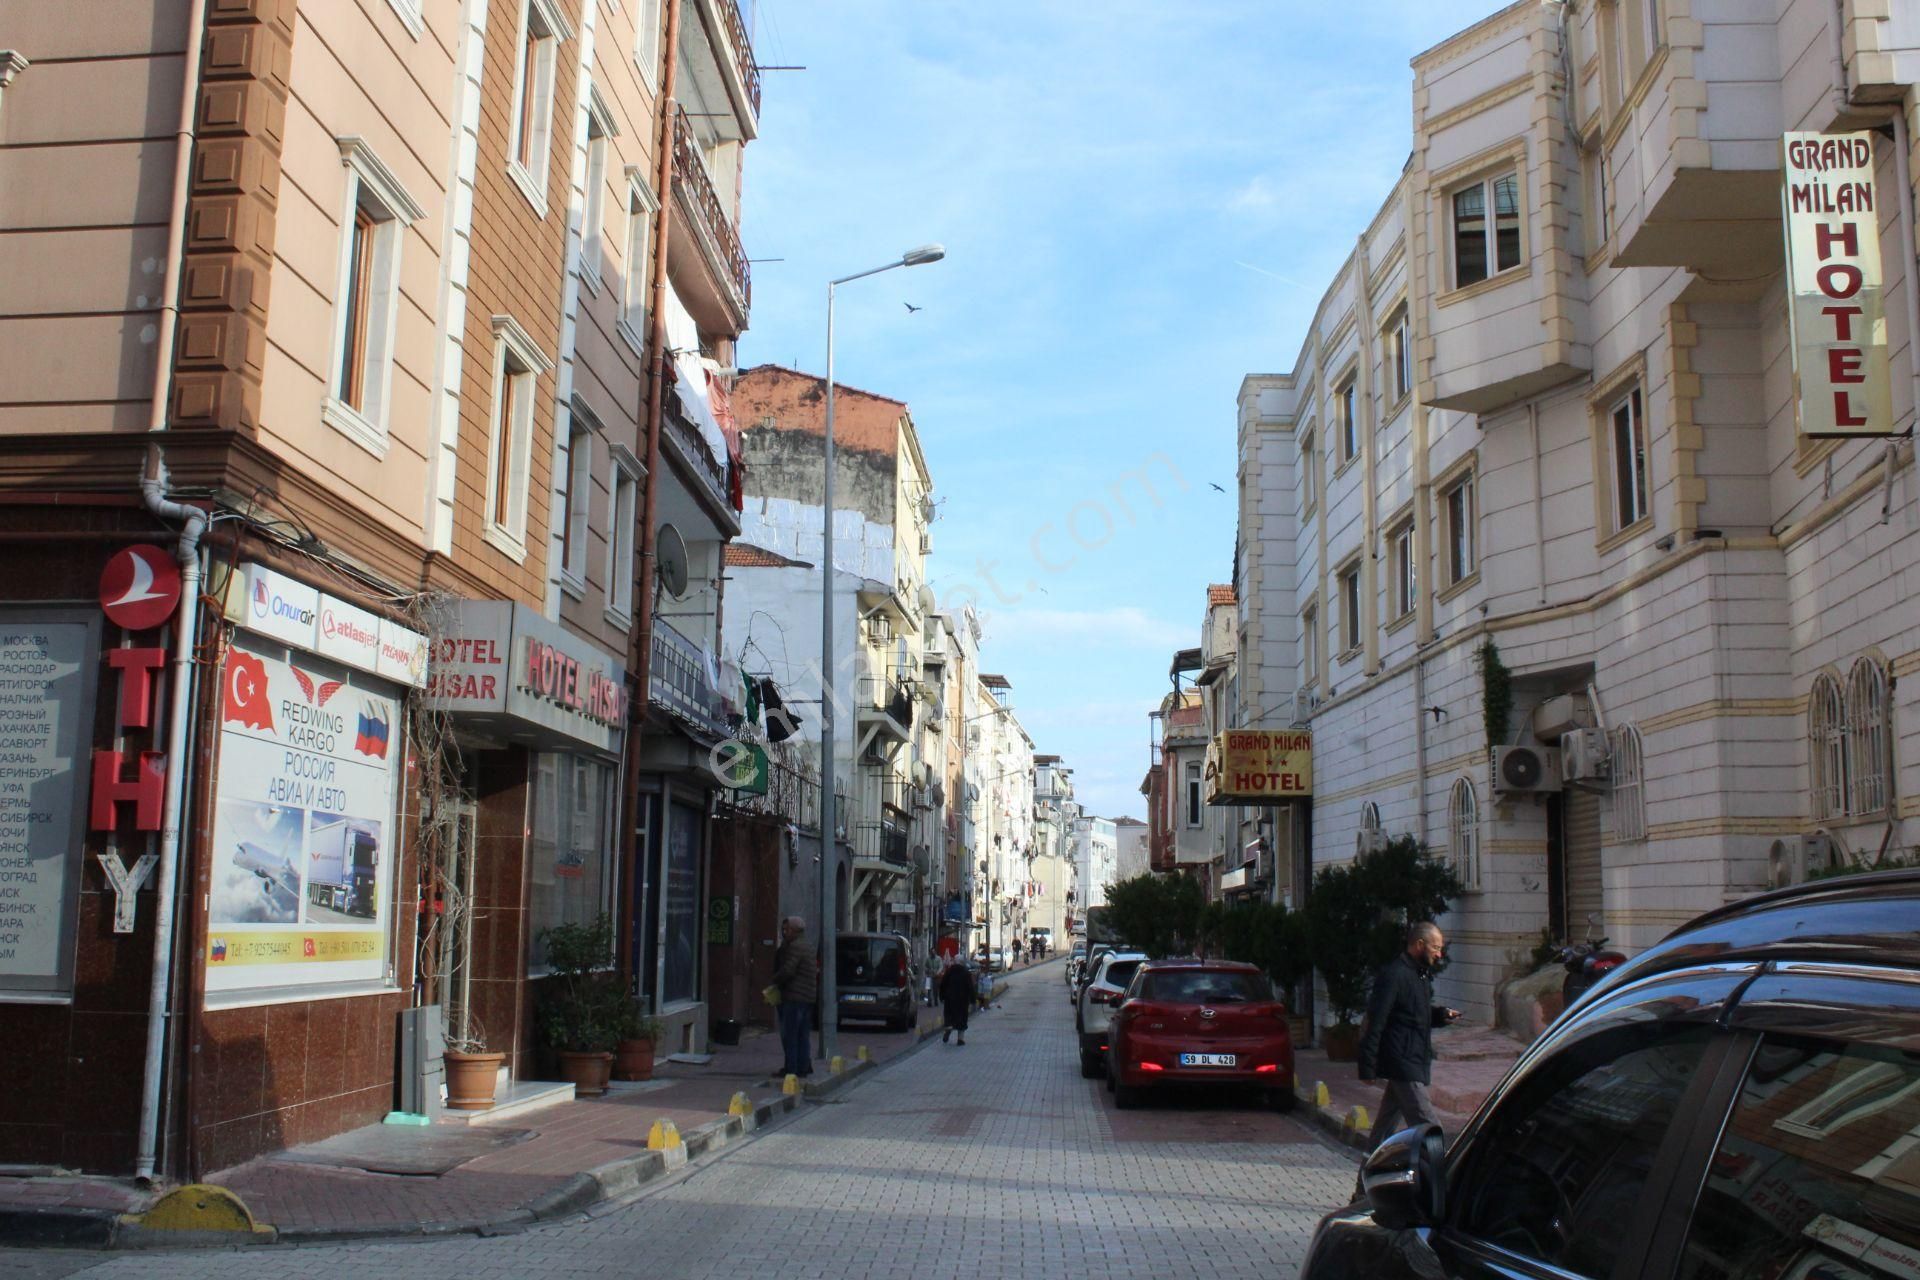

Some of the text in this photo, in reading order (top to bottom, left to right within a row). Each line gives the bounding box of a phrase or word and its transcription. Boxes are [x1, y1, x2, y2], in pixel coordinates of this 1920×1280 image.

[1788, 138, 1870, 172] GRAND
[1792, 176, 1873, 216] MİLAN
[1815, 222, 1867, 427] HOTEL
[273, 596, 315, 627] Onurair
[4, 636, 48, 646] МОСКВА
[3, 650, 48, 660] РОСТОВ
[528, 639, 583, 708] HOTEL
[282, 700, 343, 734] REDWING
[0, 738, 48, 748] САВЮРТ
[289, 725, 335, 752] KARGO
[1229, 735, 1270, 751] GRAND
[0, 754, 37, 763] АЗАНЬ
[285, 751, 335, 782] РОССИЯ
[3, 783, 24, 792] УФА
[91, 648, 166, 933] THY
[269, 777, 346, 811] АВИА И АВТО
[1235, 773, 1305, 791] HOTEL
[0, 827, 25, 837] ОЧИ
[1185, 1055, 1234, 1065] 59 DL 428
